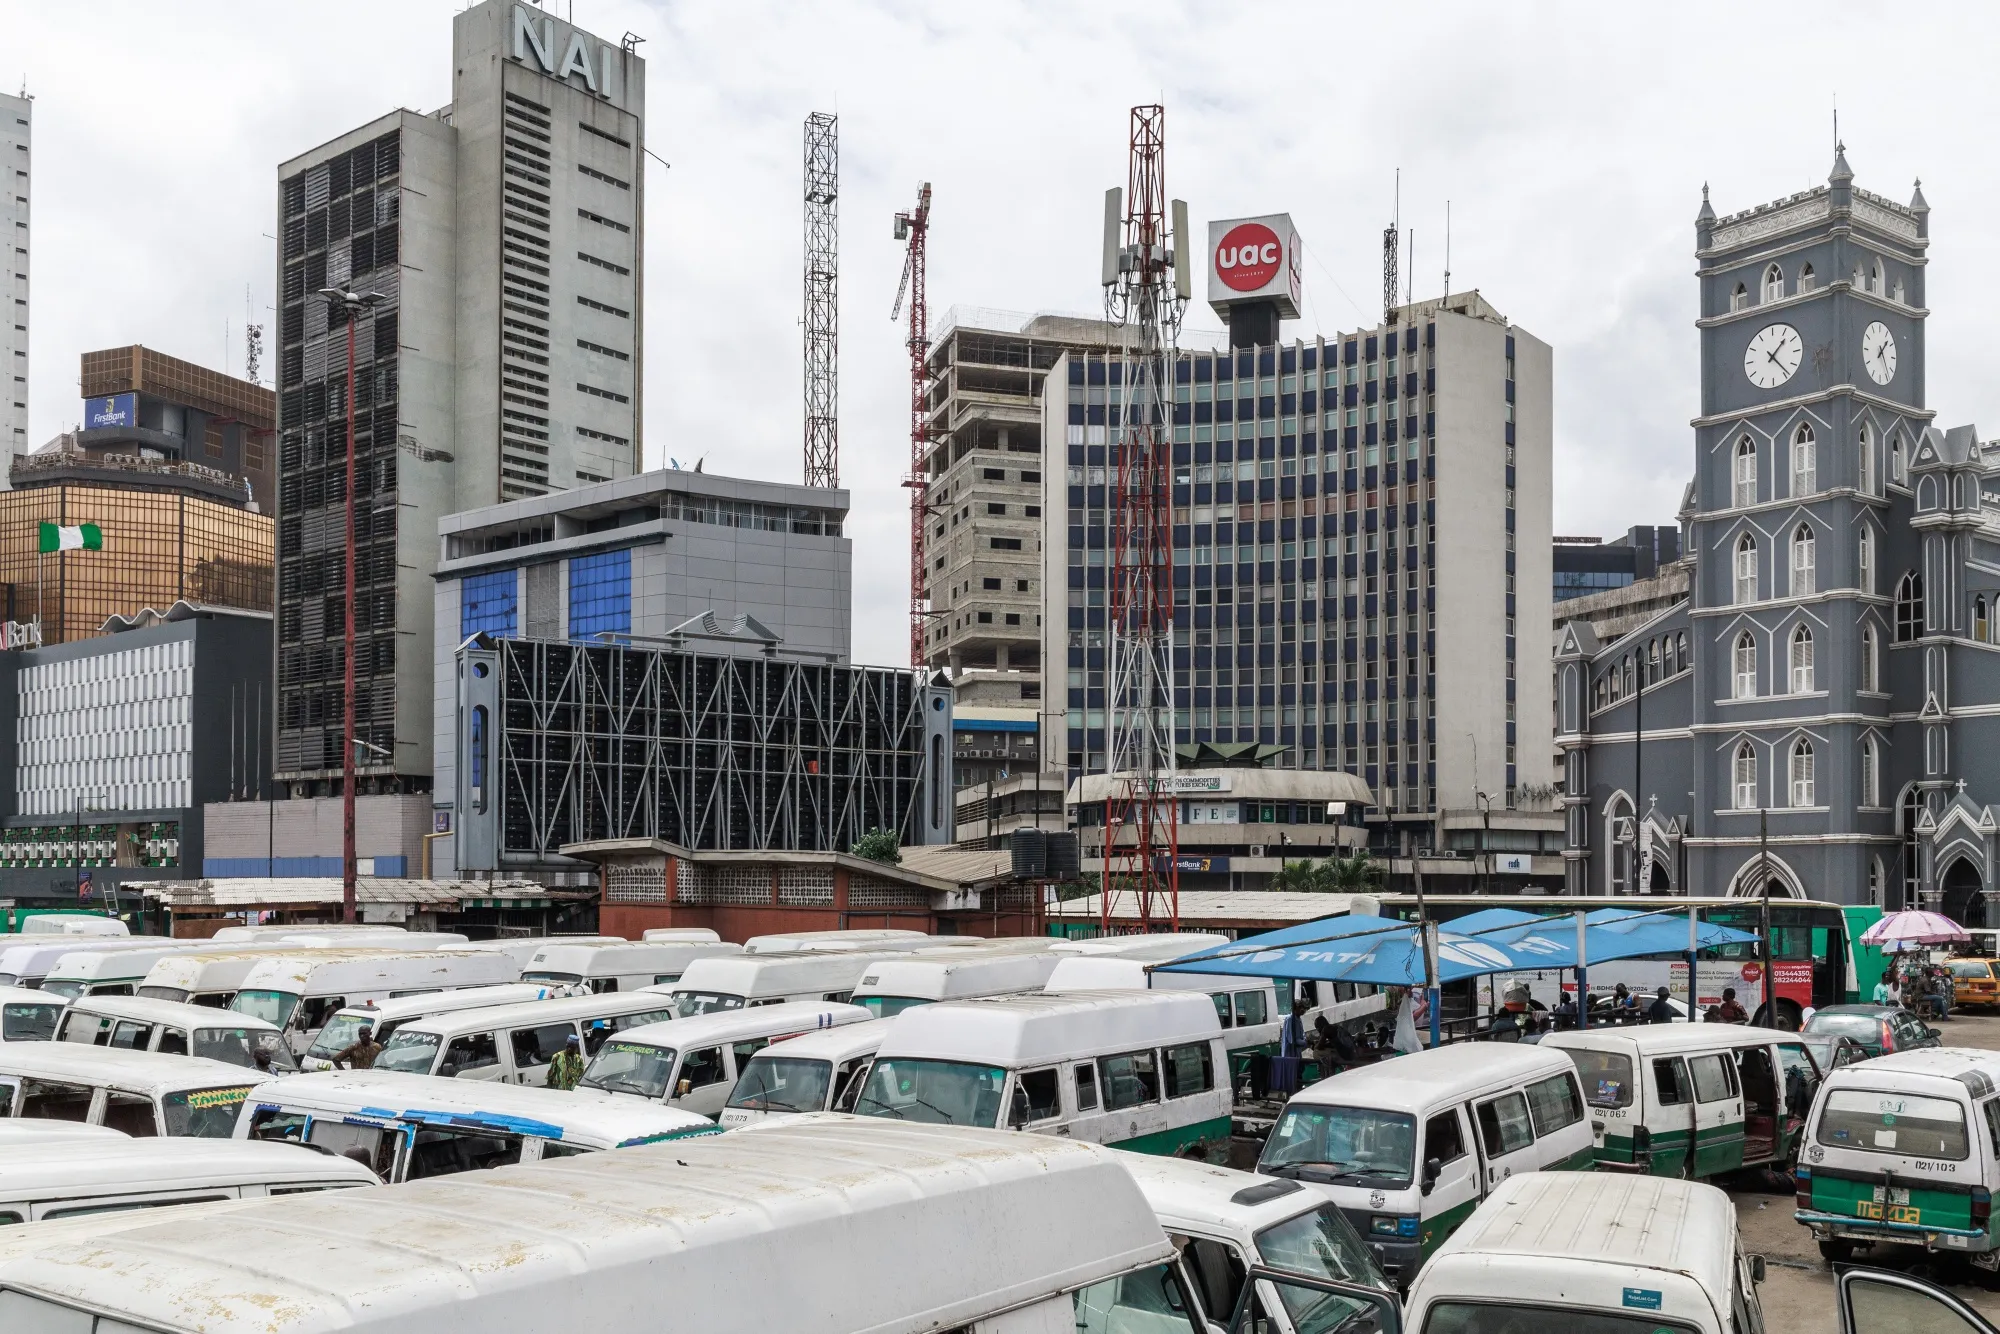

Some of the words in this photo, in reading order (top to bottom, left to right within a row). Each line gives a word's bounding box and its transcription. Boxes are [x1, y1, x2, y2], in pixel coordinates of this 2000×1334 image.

[1219, 242, 1277, 269] uac
[93, 411, 126, 423] FirstBank
[8, 613, 42, 648] Bank
[1295, 951, 1376, 964] TATA
[1915, 1160, 1956, 1173] 021/103
